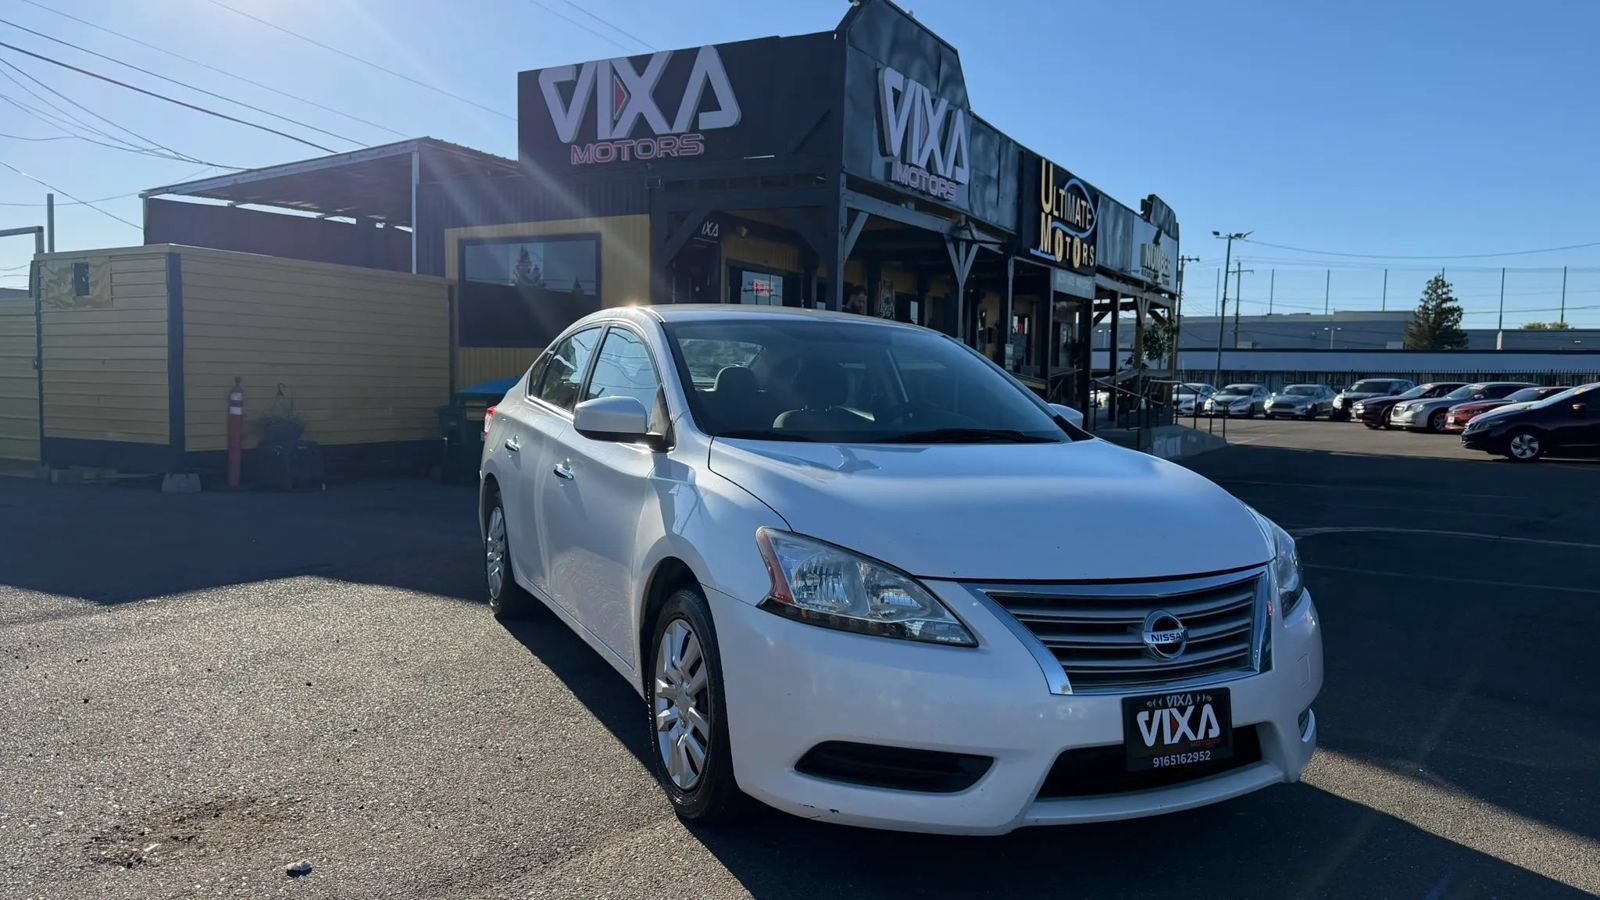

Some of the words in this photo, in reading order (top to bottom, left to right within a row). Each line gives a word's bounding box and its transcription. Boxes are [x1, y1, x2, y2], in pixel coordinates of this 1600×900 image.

[538, 45, 742, 143] VIXA
[877, 66, 970, 184] VIXA
[570, 133, 705, 165] MOTORS
[893, 161, 957, 200] MOTORS
[1041, 158, 1092, 229] ULTIMATE
[701, 220, 719, 237] IXA
[1040, 211, 1095, 268] MOTORS
[1166, 693, 1193, 707] VIXA
[1136, 703, 1221, 747] VIXA
[1152, 750, 1211, 768] 9165162952
